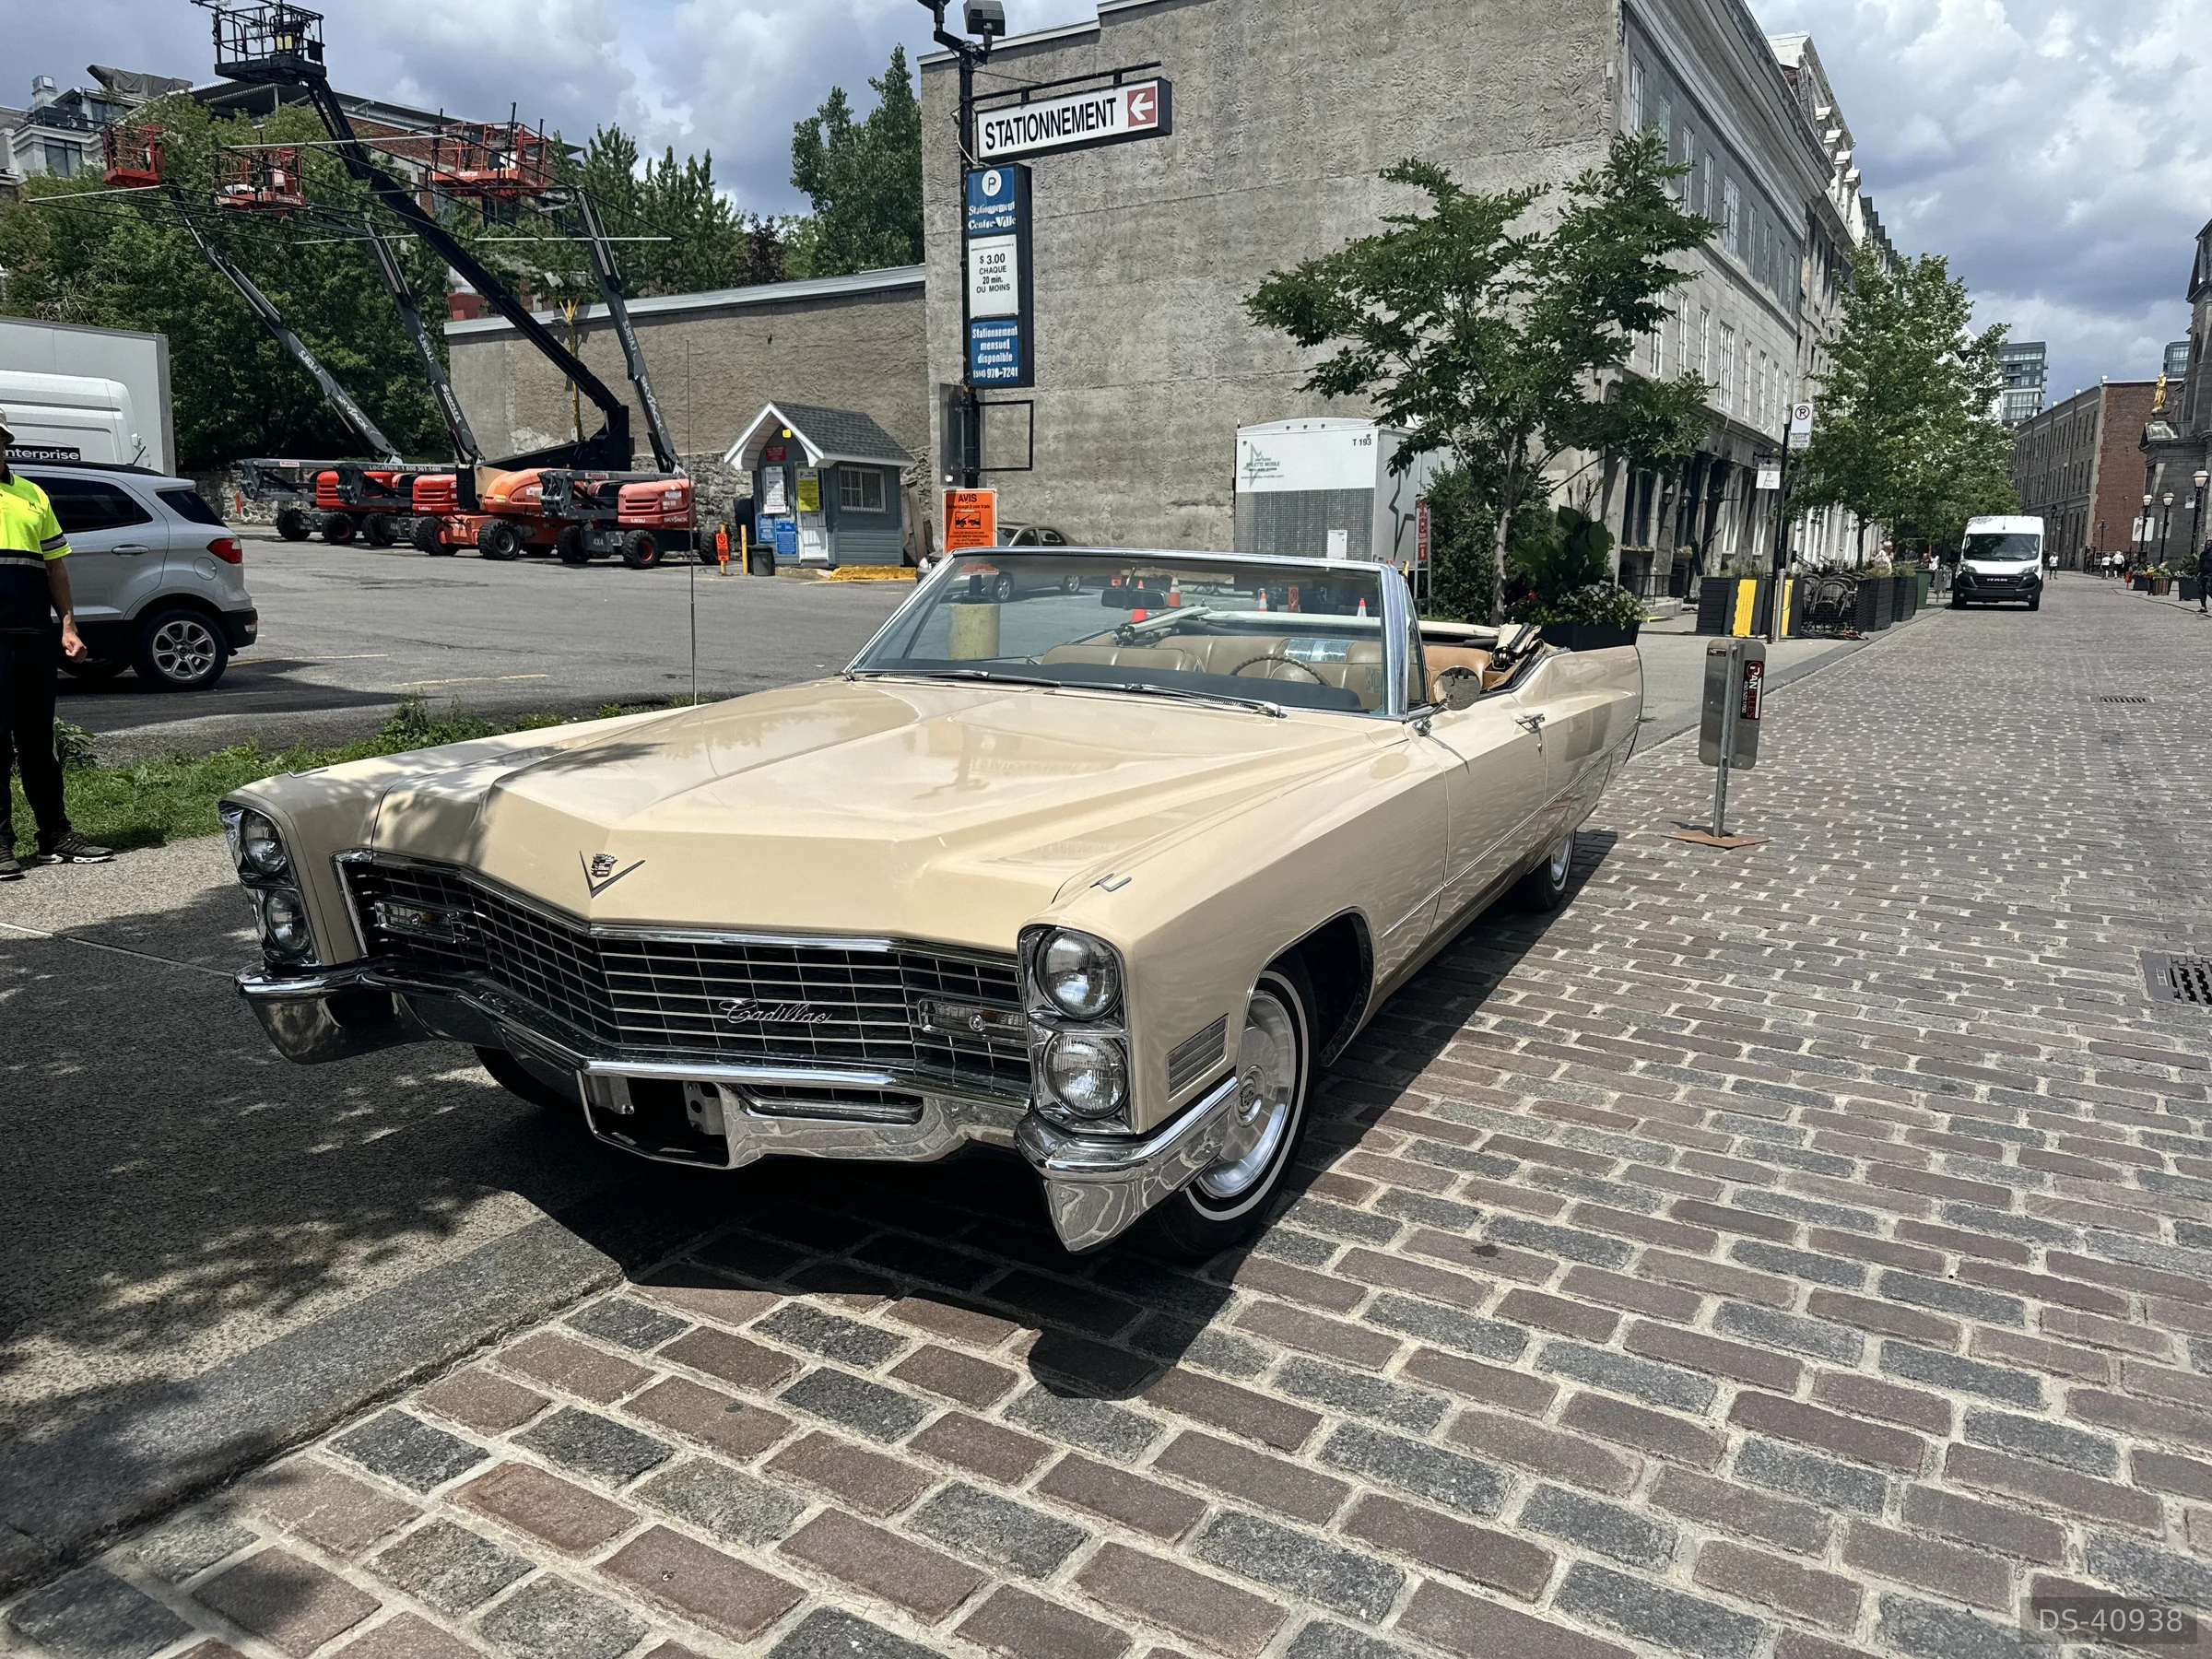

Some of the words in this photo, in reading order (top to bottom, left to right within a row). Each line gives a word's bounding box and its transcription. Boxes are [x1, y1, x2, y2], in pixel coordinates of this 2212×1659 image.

[985, 97, 1117, 150] STATIONNEMENT
[980, 255, 984, 265] $
[986, 253, 1006, 265] 3.00
[979, 265, 1007, 276] CHAQUE
[982, 276, 990, 285] 20
[991, 275, 1004, 284] min.
[976, 286, 986, 294] OU
[989, 283, 1011, 292] MOINS
[972, 325, 1018, 339] Stationnement
[980, 338, 1010, 351] mensuel
[977, 351, 1013, 365] disponible
[441, 383, 463, 424] SIMPLEX
[641, 375, 664, 430] SKYJACK
[336, 395, 369, 430] SKYJACK
[1352, 438, 1358, 447] T
[1359, 438, 1372, 447] 193
[3, 448, 79, 460] nterprise
[959, 493, 977, 503] AVIS
[719, 998, 832, 1025] Cadillac
